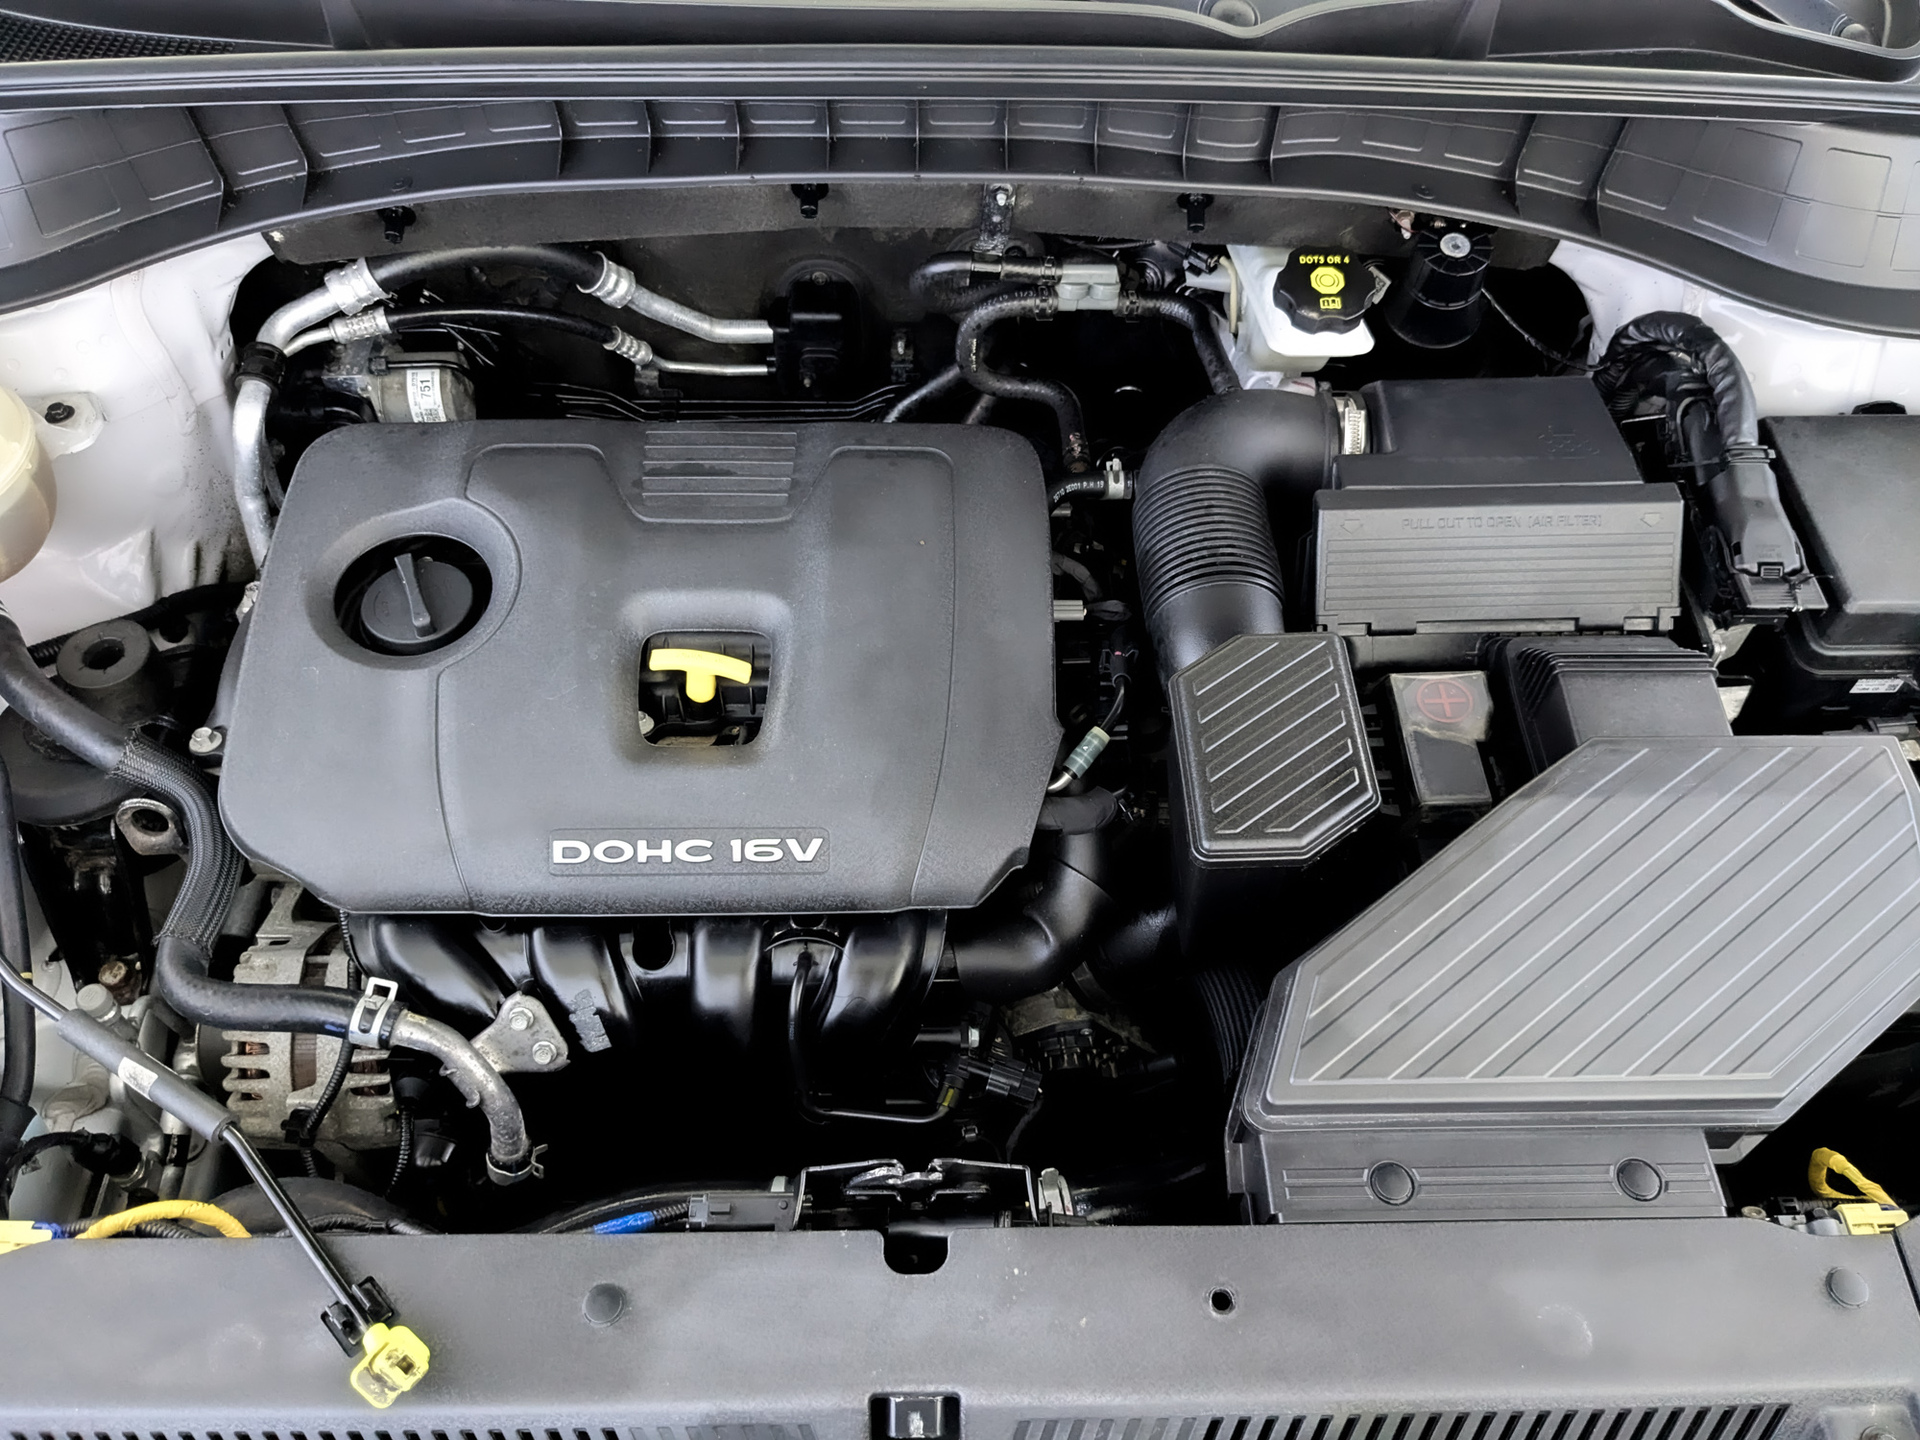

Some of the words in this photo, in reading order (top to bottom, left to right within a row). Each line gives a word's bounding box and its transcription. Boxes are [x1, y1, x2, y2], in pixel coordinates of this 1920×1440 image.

[1299, 254, 1325, 264] DOT3
[1326, 254, 1342, 264] OR
[1343, 254, 1350, 264] 4
[419, 379, 431, 400] 751
[1096, 479, 1105, 489] 19
[1402, 518, 1435, 530] PULL
[1437, 517, 1464, 529] OUT
[1466, 516, 1483, 528] TO
[1486, 515, 1522, 528] OPEN
[552, 839, 714, 864] DOHC
[730, 837, 824, 863] 16V
